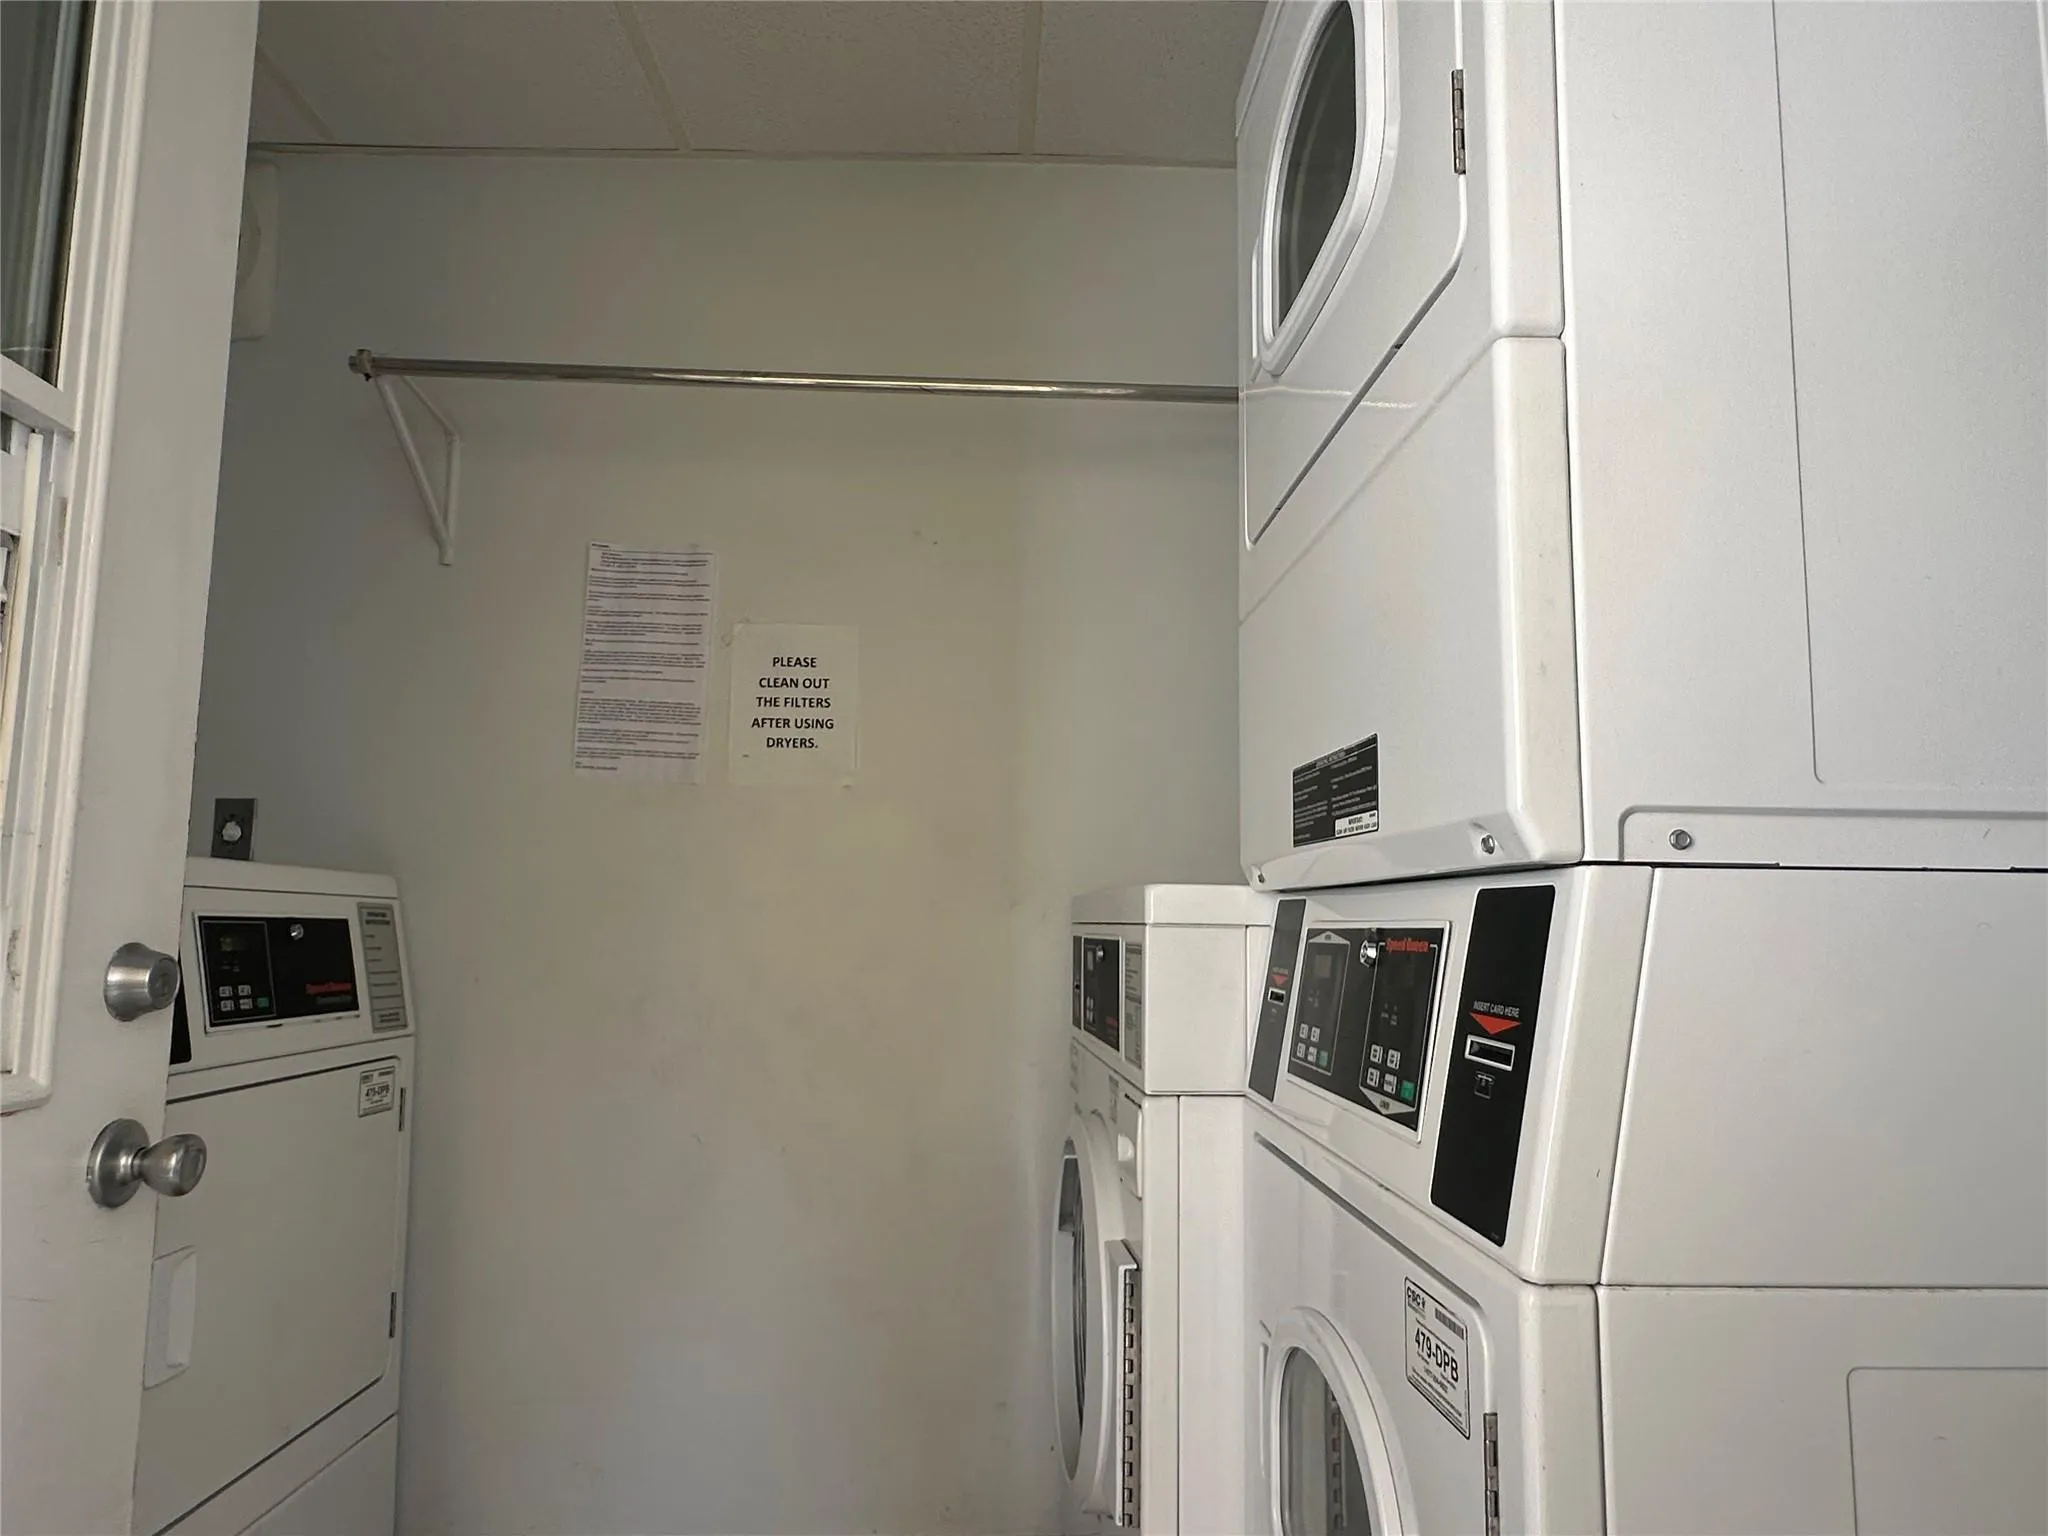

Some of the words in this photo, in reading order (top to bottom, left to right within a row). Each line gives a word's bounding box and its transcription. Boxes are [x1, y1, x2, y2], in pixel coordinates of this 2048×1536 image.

[772, 656, 817, 668] PLEASE
[758, 677, 799, 689] CLEAN
[802, 678, 830, 690] OUT
[756, 696, 781, 708] THE
[783, 697, 831, 708] FILTERS
[751, 717, 791, 729] AFTER
[794, 718, 834, 729] USING
[766, 737, 818, 748] DRYERS.
[1473, 1001, 1490, 1012] INSERT
[1490, 1003, 1504, 1016] CARD
[1504, 1006, 1521, 1018] HERE
[1415, 1328, 1458, 1383] 479-DPB
